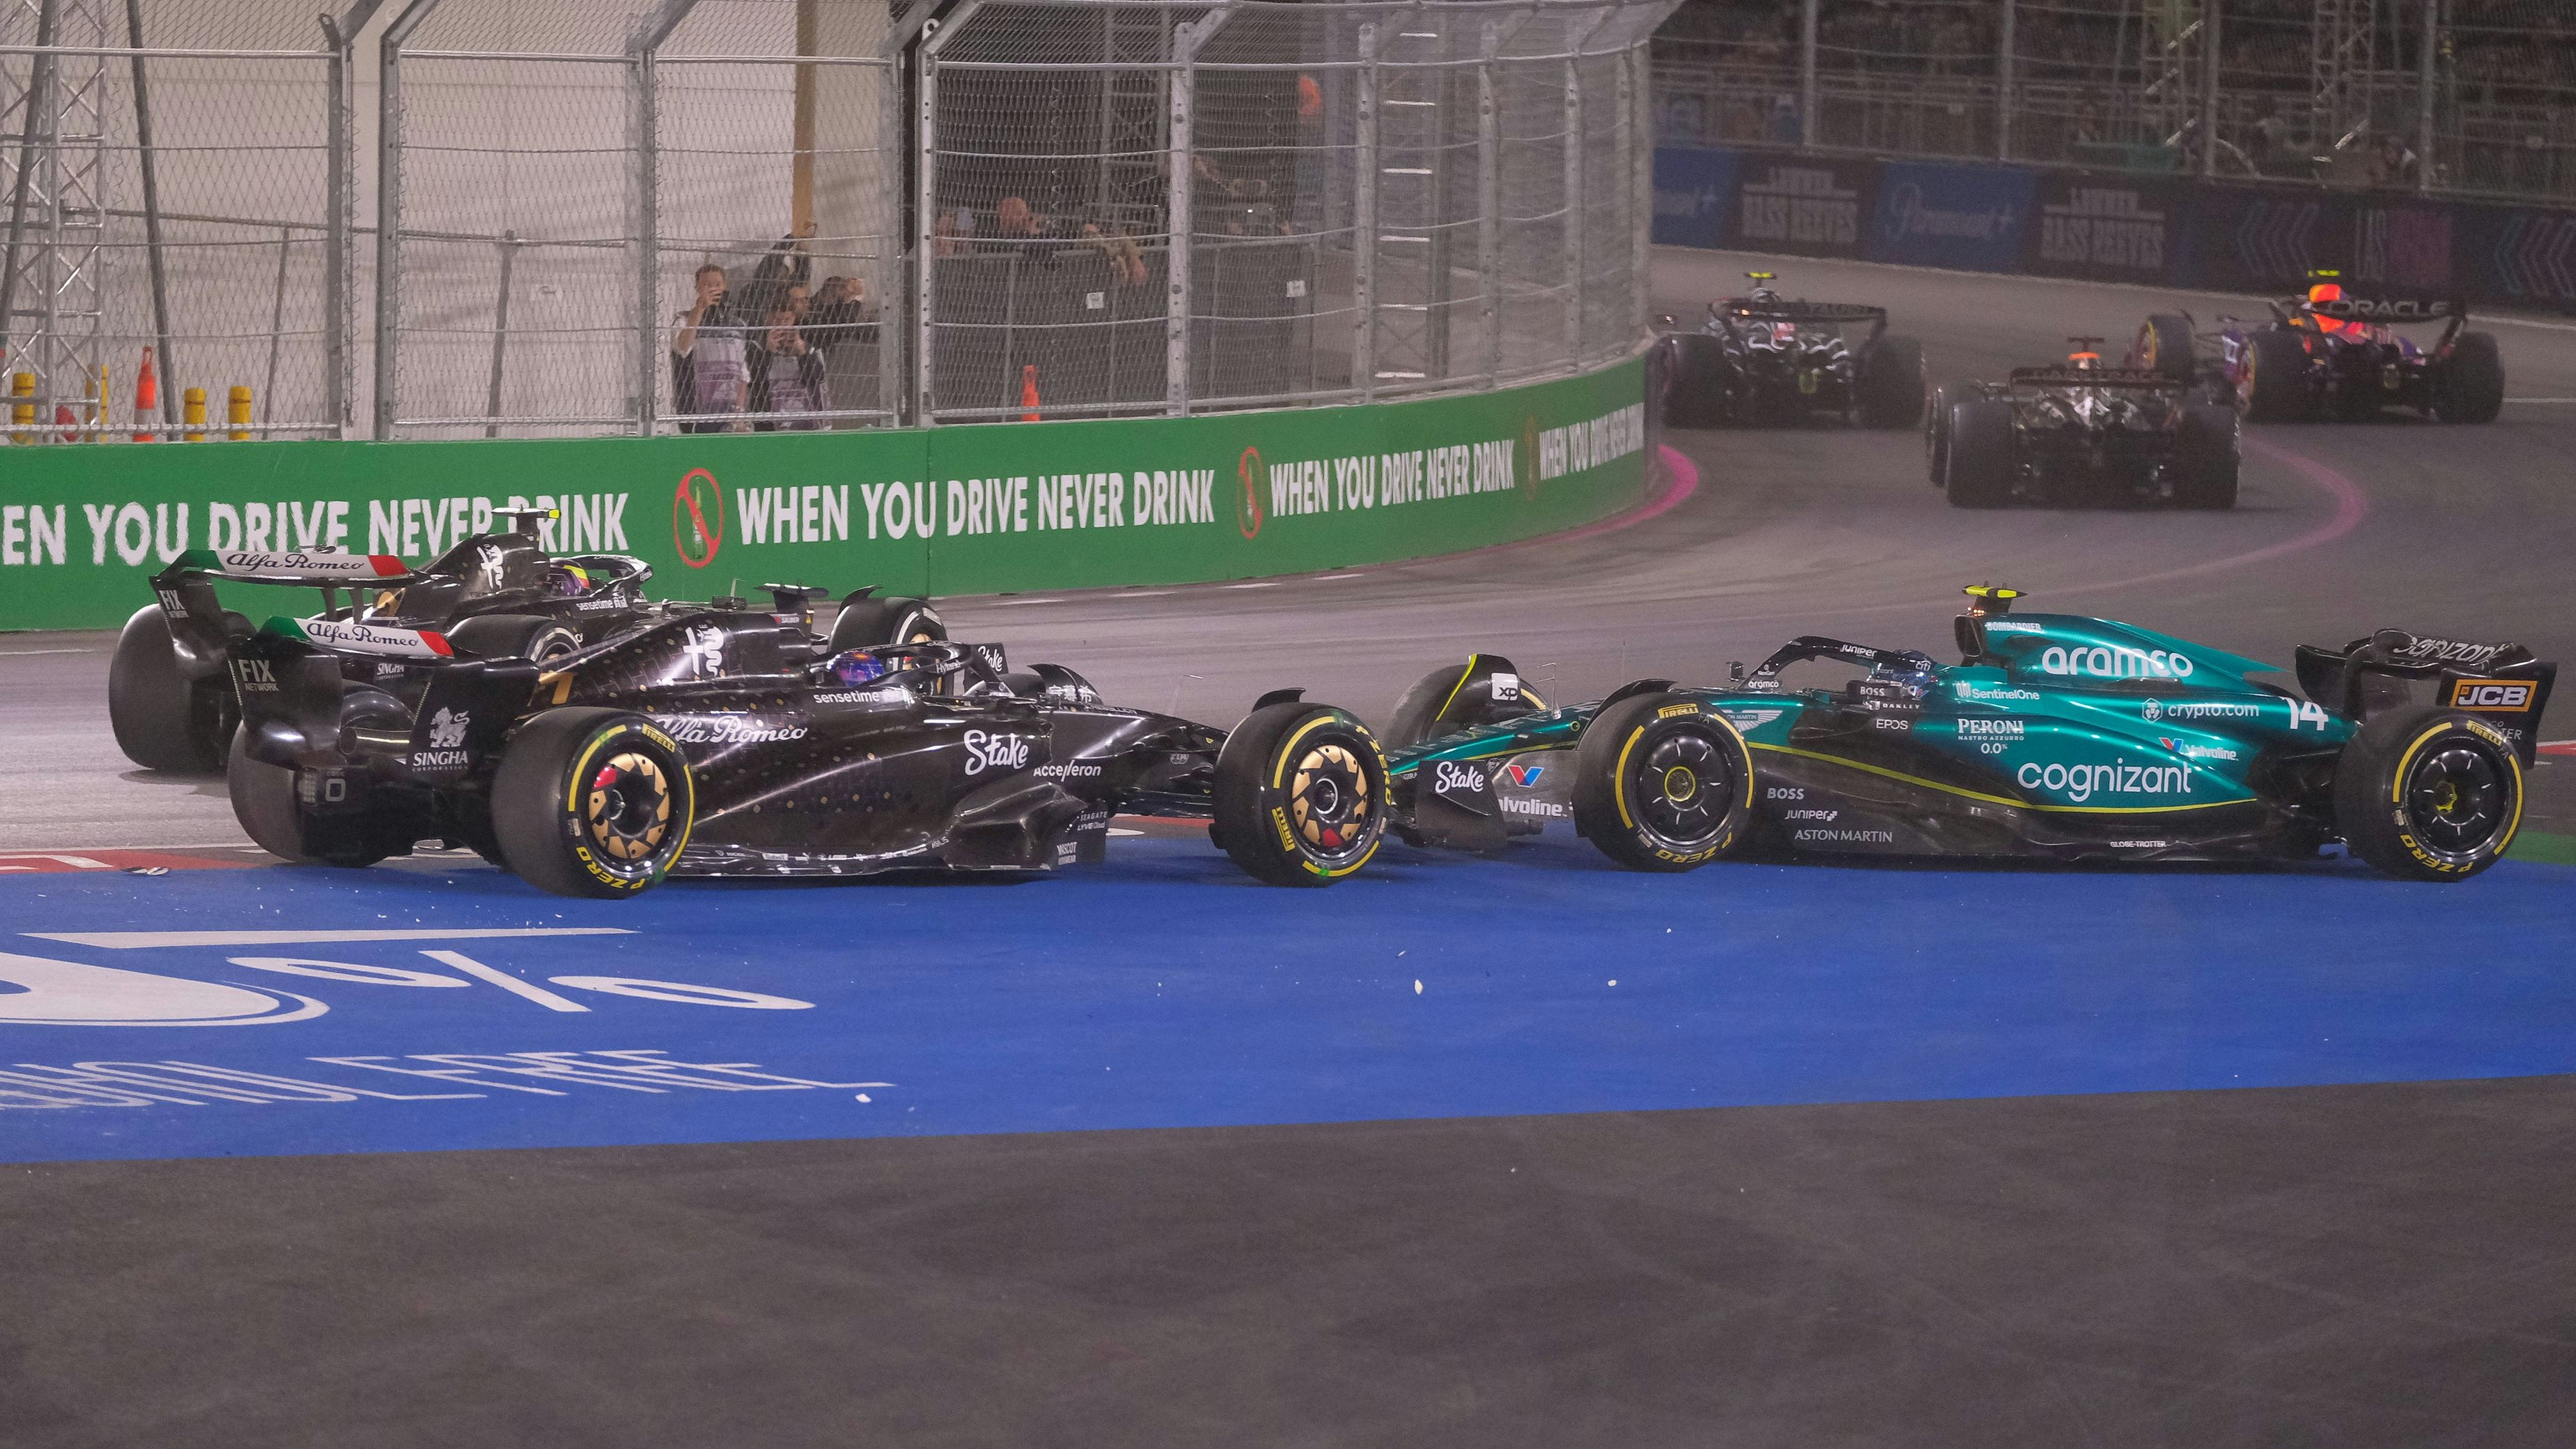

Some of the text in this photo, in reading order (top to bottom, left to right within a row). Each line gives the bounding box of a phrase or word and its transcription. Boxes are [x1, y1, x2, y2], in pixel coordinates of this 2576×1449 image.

[2326, 299, 2450, 315] ORACLE
[1539, 427, 1567, 480] WHEN
[1569, 422, 1588, 472] YOU
[1270, 439, 1514, 517] WHEN YOU DRIVE NEVER DRINK
[736, 470, 1215, 545] WHEN YOU DRIVE NEVER DRINK
[2, 505, 67, 565] EN
[82, 501, 189, 566] YOU
[208, 501, 350, 555] DRIVE
[227, 552, 364, 571] Alfa Romeo
[158, 590, 185, 611] FIX
[307, 622, 418, 647] Alfa Romeo
[1986, 621, 2042, 632] BOMBARDIER
[238, 658, 276, 683] FIX
[2042, 647, 2193, 678] aramco
[244, 682, 279, 692] NETWORK
[1748, 680, 1780, 689] aramco
[1860, 686, 1885, 697] BOSS
[1972, 688, 2040, 700] SentinelOne
[813, 690, 881, 704] sensetime
[2458, 686, 2528, 706] JCB
[1658, 703, 1700, 719] PIRELLI
[2167, 704, 2260, 719] crypto.com
[2279, 696, 2329, 731] 14
[709, 715, 808, 743] Romeo
[1876, 719, 1909, 730] EPOS
[1957, 718, 2025, 734] PERONI
[2466, 719, 2503, 747] PIRELLI
[642, 723, 676, 754] PIRELLI
[1981, 743, 2008, 754] 0.0%
[412, 750, 468, 768] SINGHA
[963, 729, 1029, 776] Stake
[1033, 759, 1101, 782] Accelleron
[1435, 761, 1484, 793] Stake
[2017, 757, 2192, 802] cognizant
[1767, 787, 1805, 800] BOSS
[1498, 796, 1564, 817] alvoline
[1794, 829, 1893, 843] ASTON MARTIN
[1654, 844, 1717, 864] ZERO
[2400, 834, 2456, 872] ZERO
[575, 846, 630, 889] ZERO
